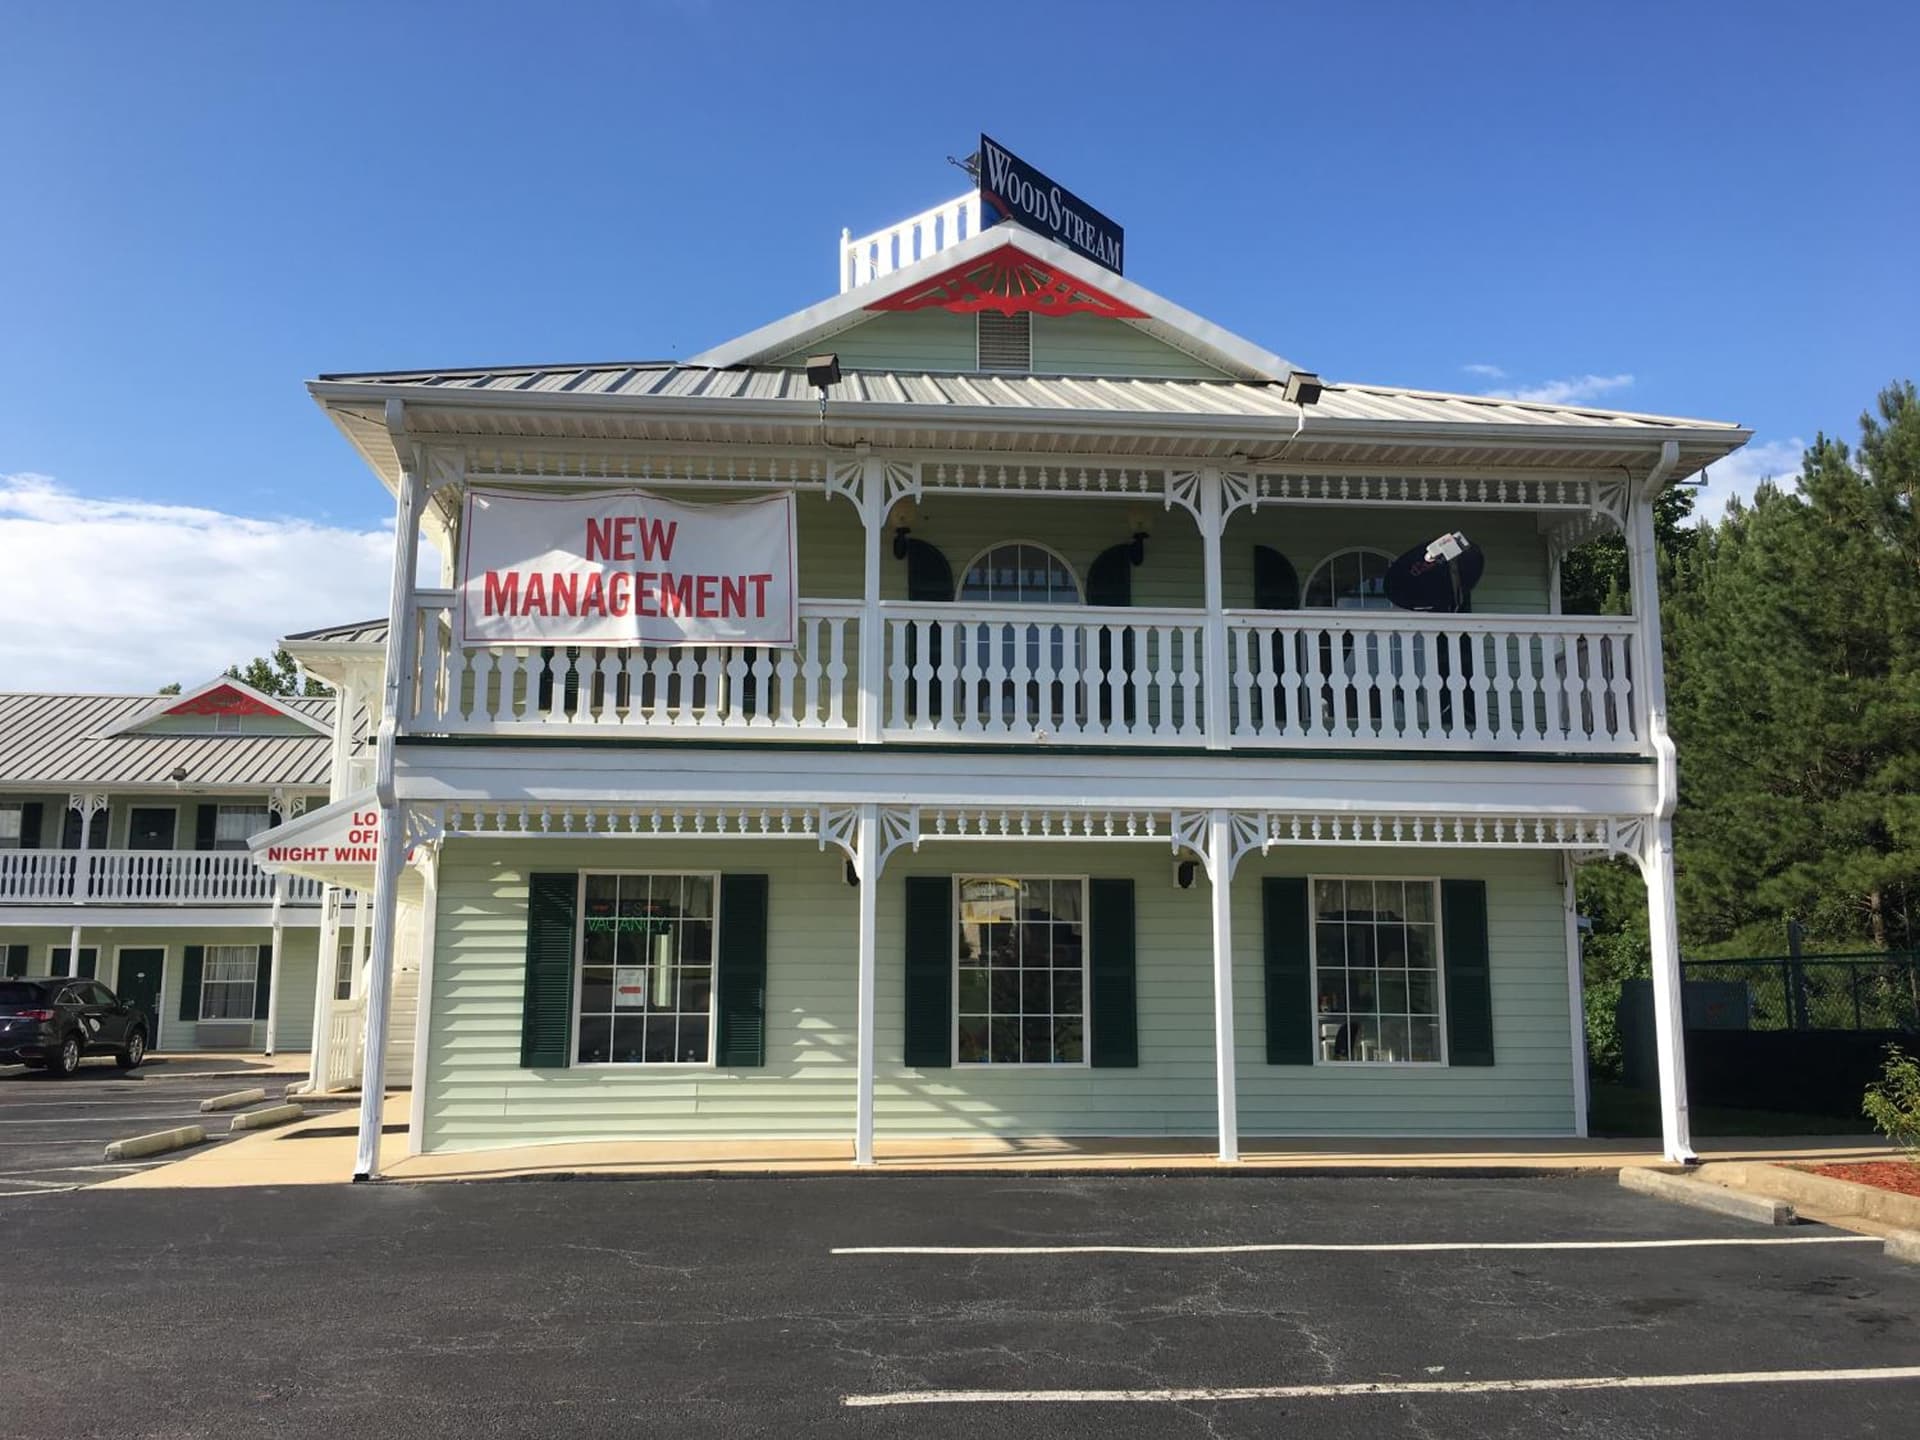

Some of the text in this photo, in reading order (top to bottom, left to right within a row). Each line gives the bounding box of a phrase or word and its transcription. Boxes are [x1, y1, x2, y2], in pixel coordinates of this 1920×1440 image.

[585, 516, 678, 562] NEW
[483, 570, 773, 618] MANAGEMENT
[353, 812, 378, 826] LO
[268, 847, 327, 862] NIGHT
